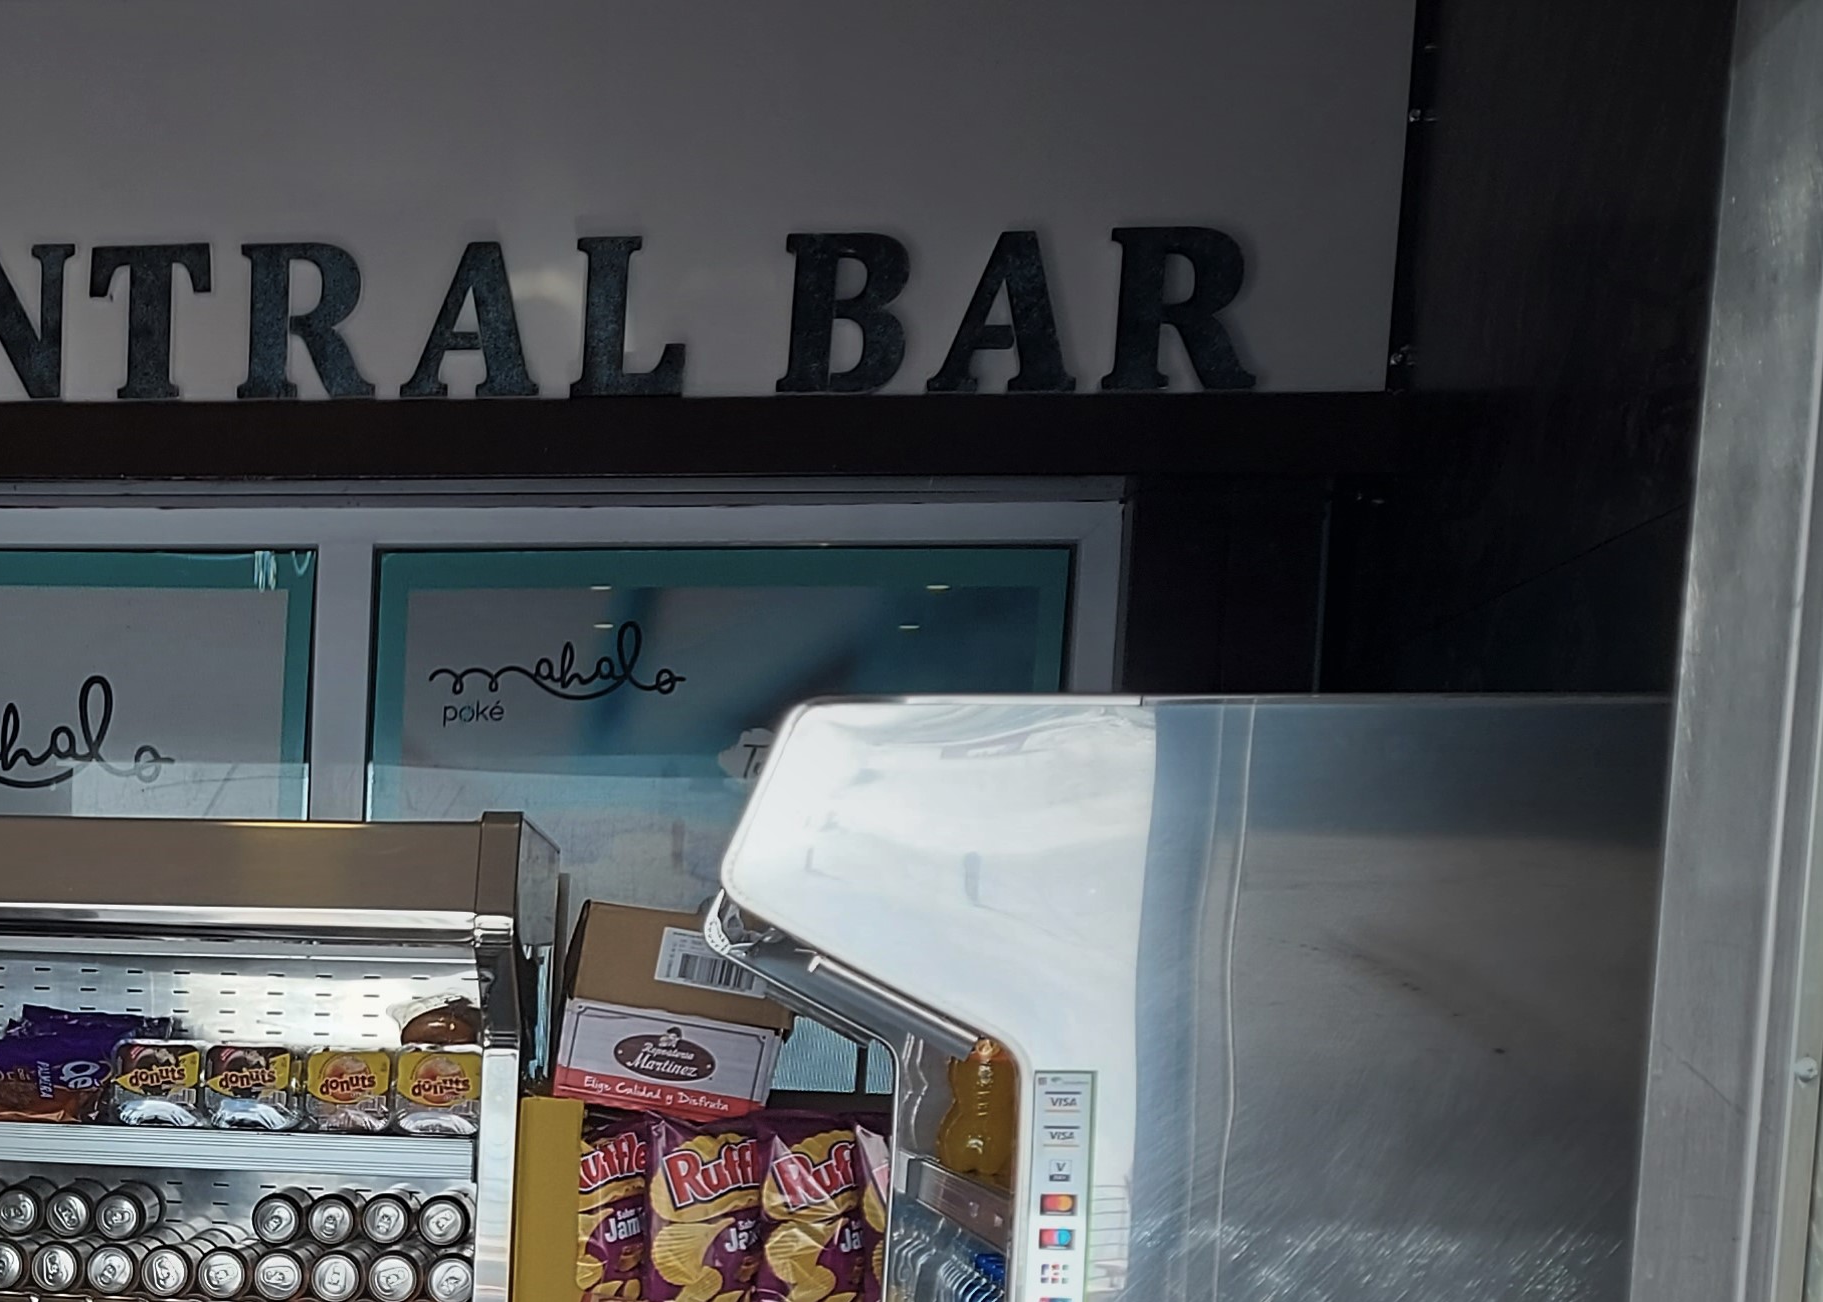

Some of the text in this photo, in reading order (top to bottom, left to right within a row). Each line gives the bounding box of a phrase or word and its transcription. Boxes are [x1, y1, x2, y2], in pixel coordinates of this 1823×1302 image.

[776, 226, 1256, 395] BAR
[429, 621, 686, 701] mahalo
[441, 699, 506, 728] poké
[129, 1065, 186, 1088] donuts
[218, 1068, 277, 1089] donuts
[319, 1073, 376, 1095] donuts
[411, 1077, 471, 1097] donuts
[584, 1075, 729, 1111] Elige Calidad y Disfruta
[1050, 1096, 1078, 1107] VISA
[1049, 1131, 1075, 1140] VISA
[663, 1139, 760, 1209] Ruffl
[605, 1215, 645, 1243] Jam
